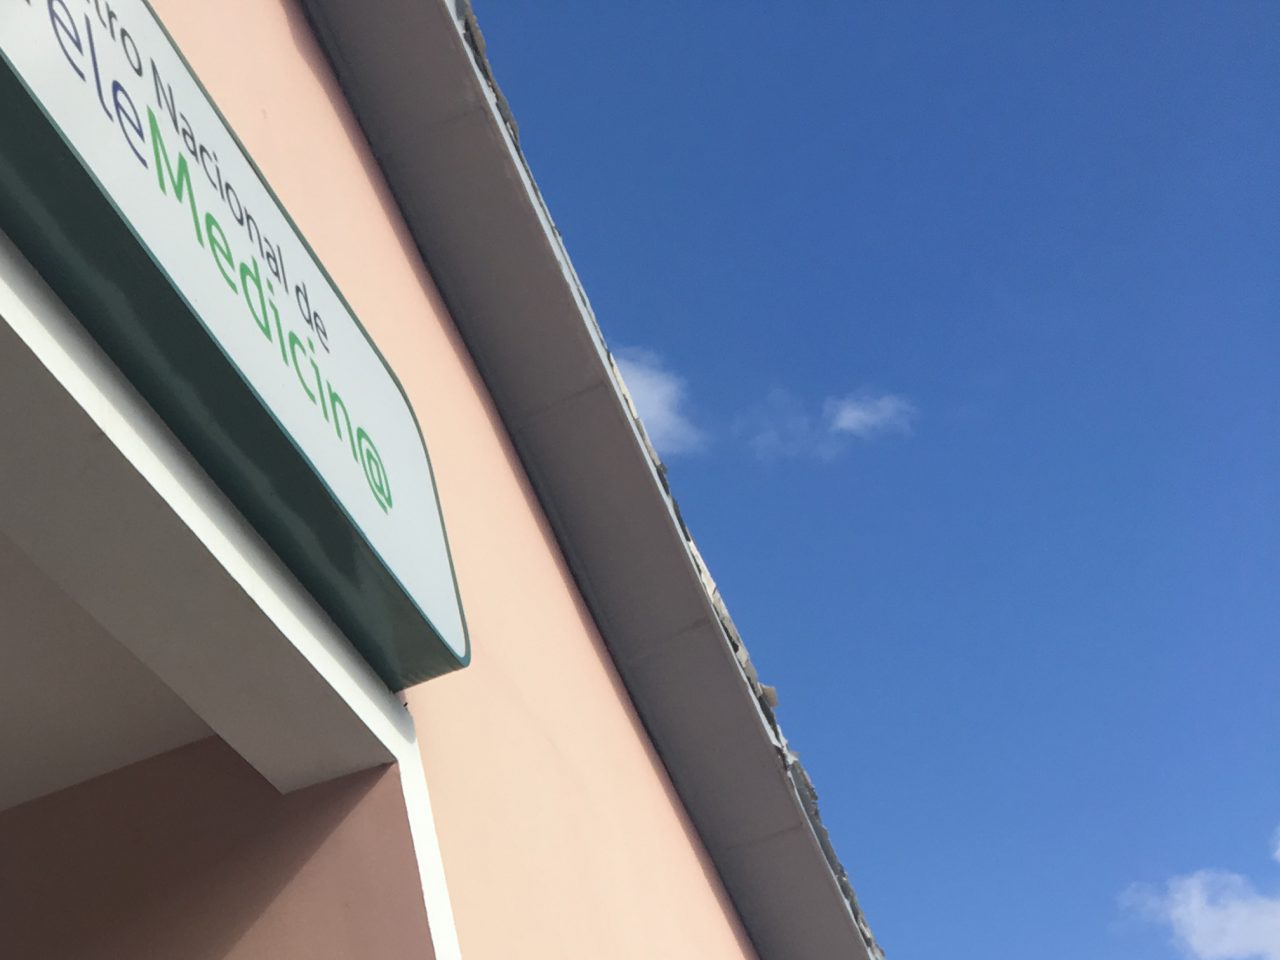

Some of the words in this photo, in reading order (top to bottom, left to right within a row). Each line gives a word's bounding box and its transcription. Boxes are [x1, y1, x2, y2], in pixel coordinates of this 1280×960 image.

[46, 0, 393, 515] eleMedicin@
[150, 57, 289, 295] Nacional
[294, 282, 330, 354] de
